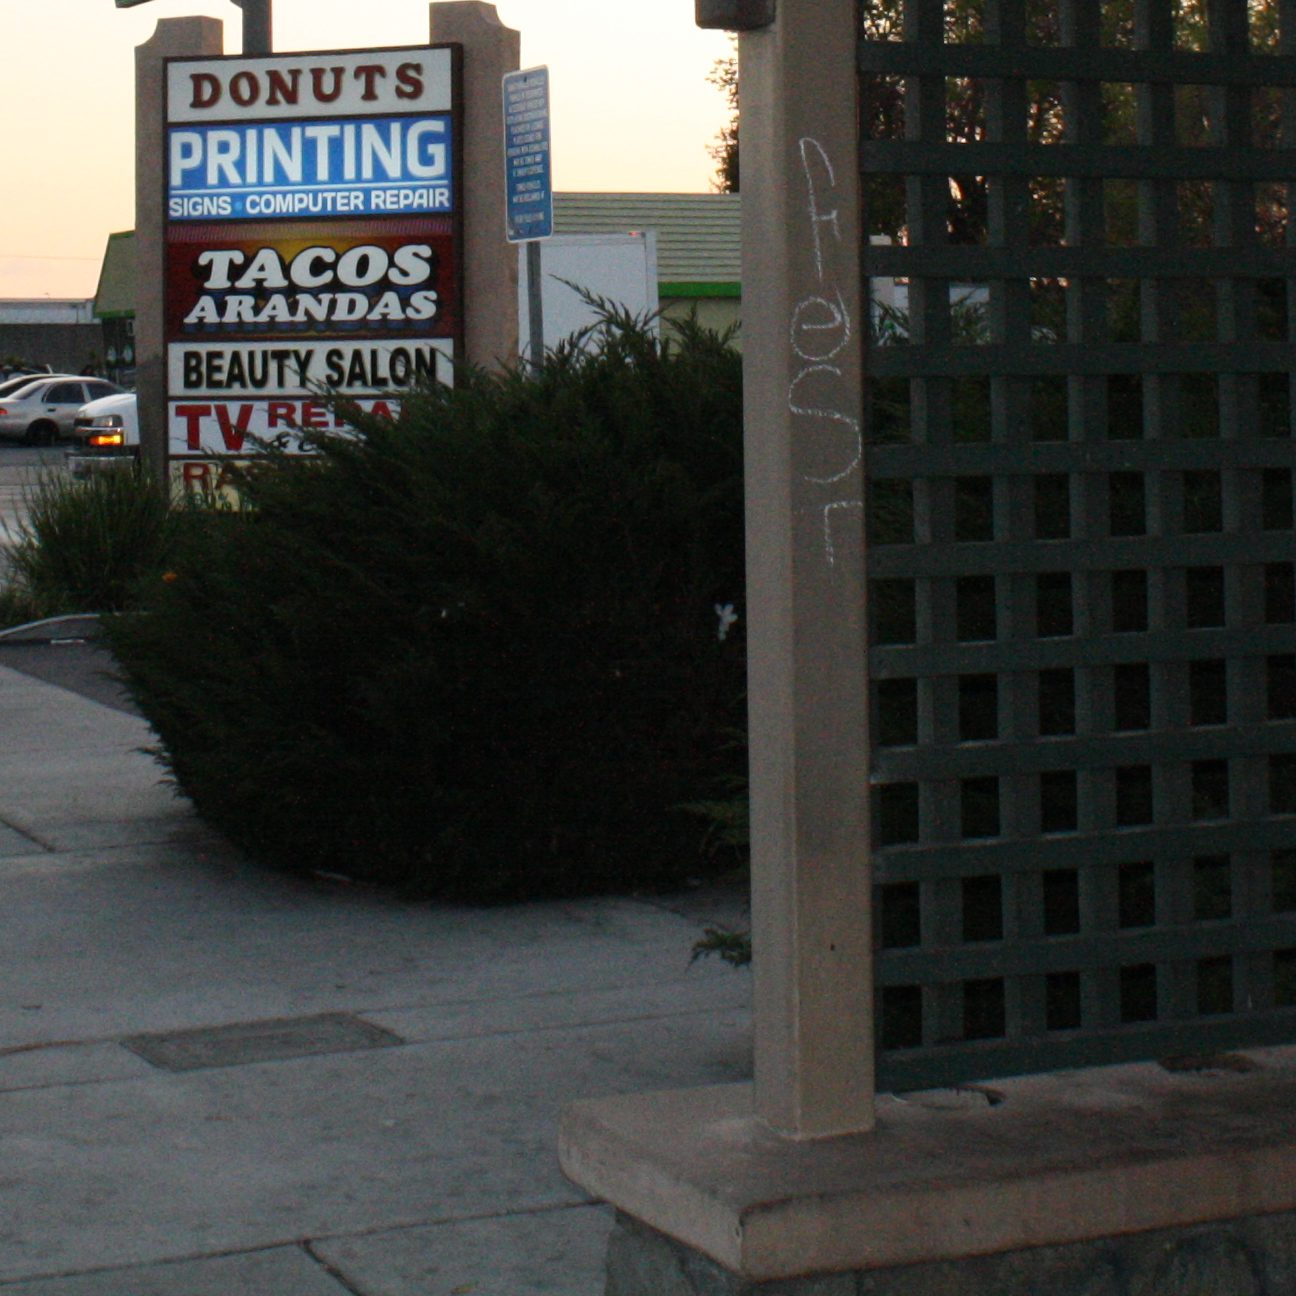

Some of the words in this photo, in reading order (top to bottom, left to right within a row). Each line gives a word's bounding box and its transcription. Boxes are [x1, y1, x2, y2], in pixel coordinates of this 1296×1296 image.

[189, 62, 425, 109] DONUTS
[169, 119, 447, 186] PRINTING
[169, 195, 233, 217] SIGNS
[245, 190, 365, 215] COMPUTER
[370, 187, 451, 210] REPAIR
[197, 244, 433, 290] TACOS
[183, 290, 439, 324] ARANDAS
[183, 349, 315, 389] BEAUTY
[325, 347, 438, 388] SALON
[175, 403, 254, 452] TV
